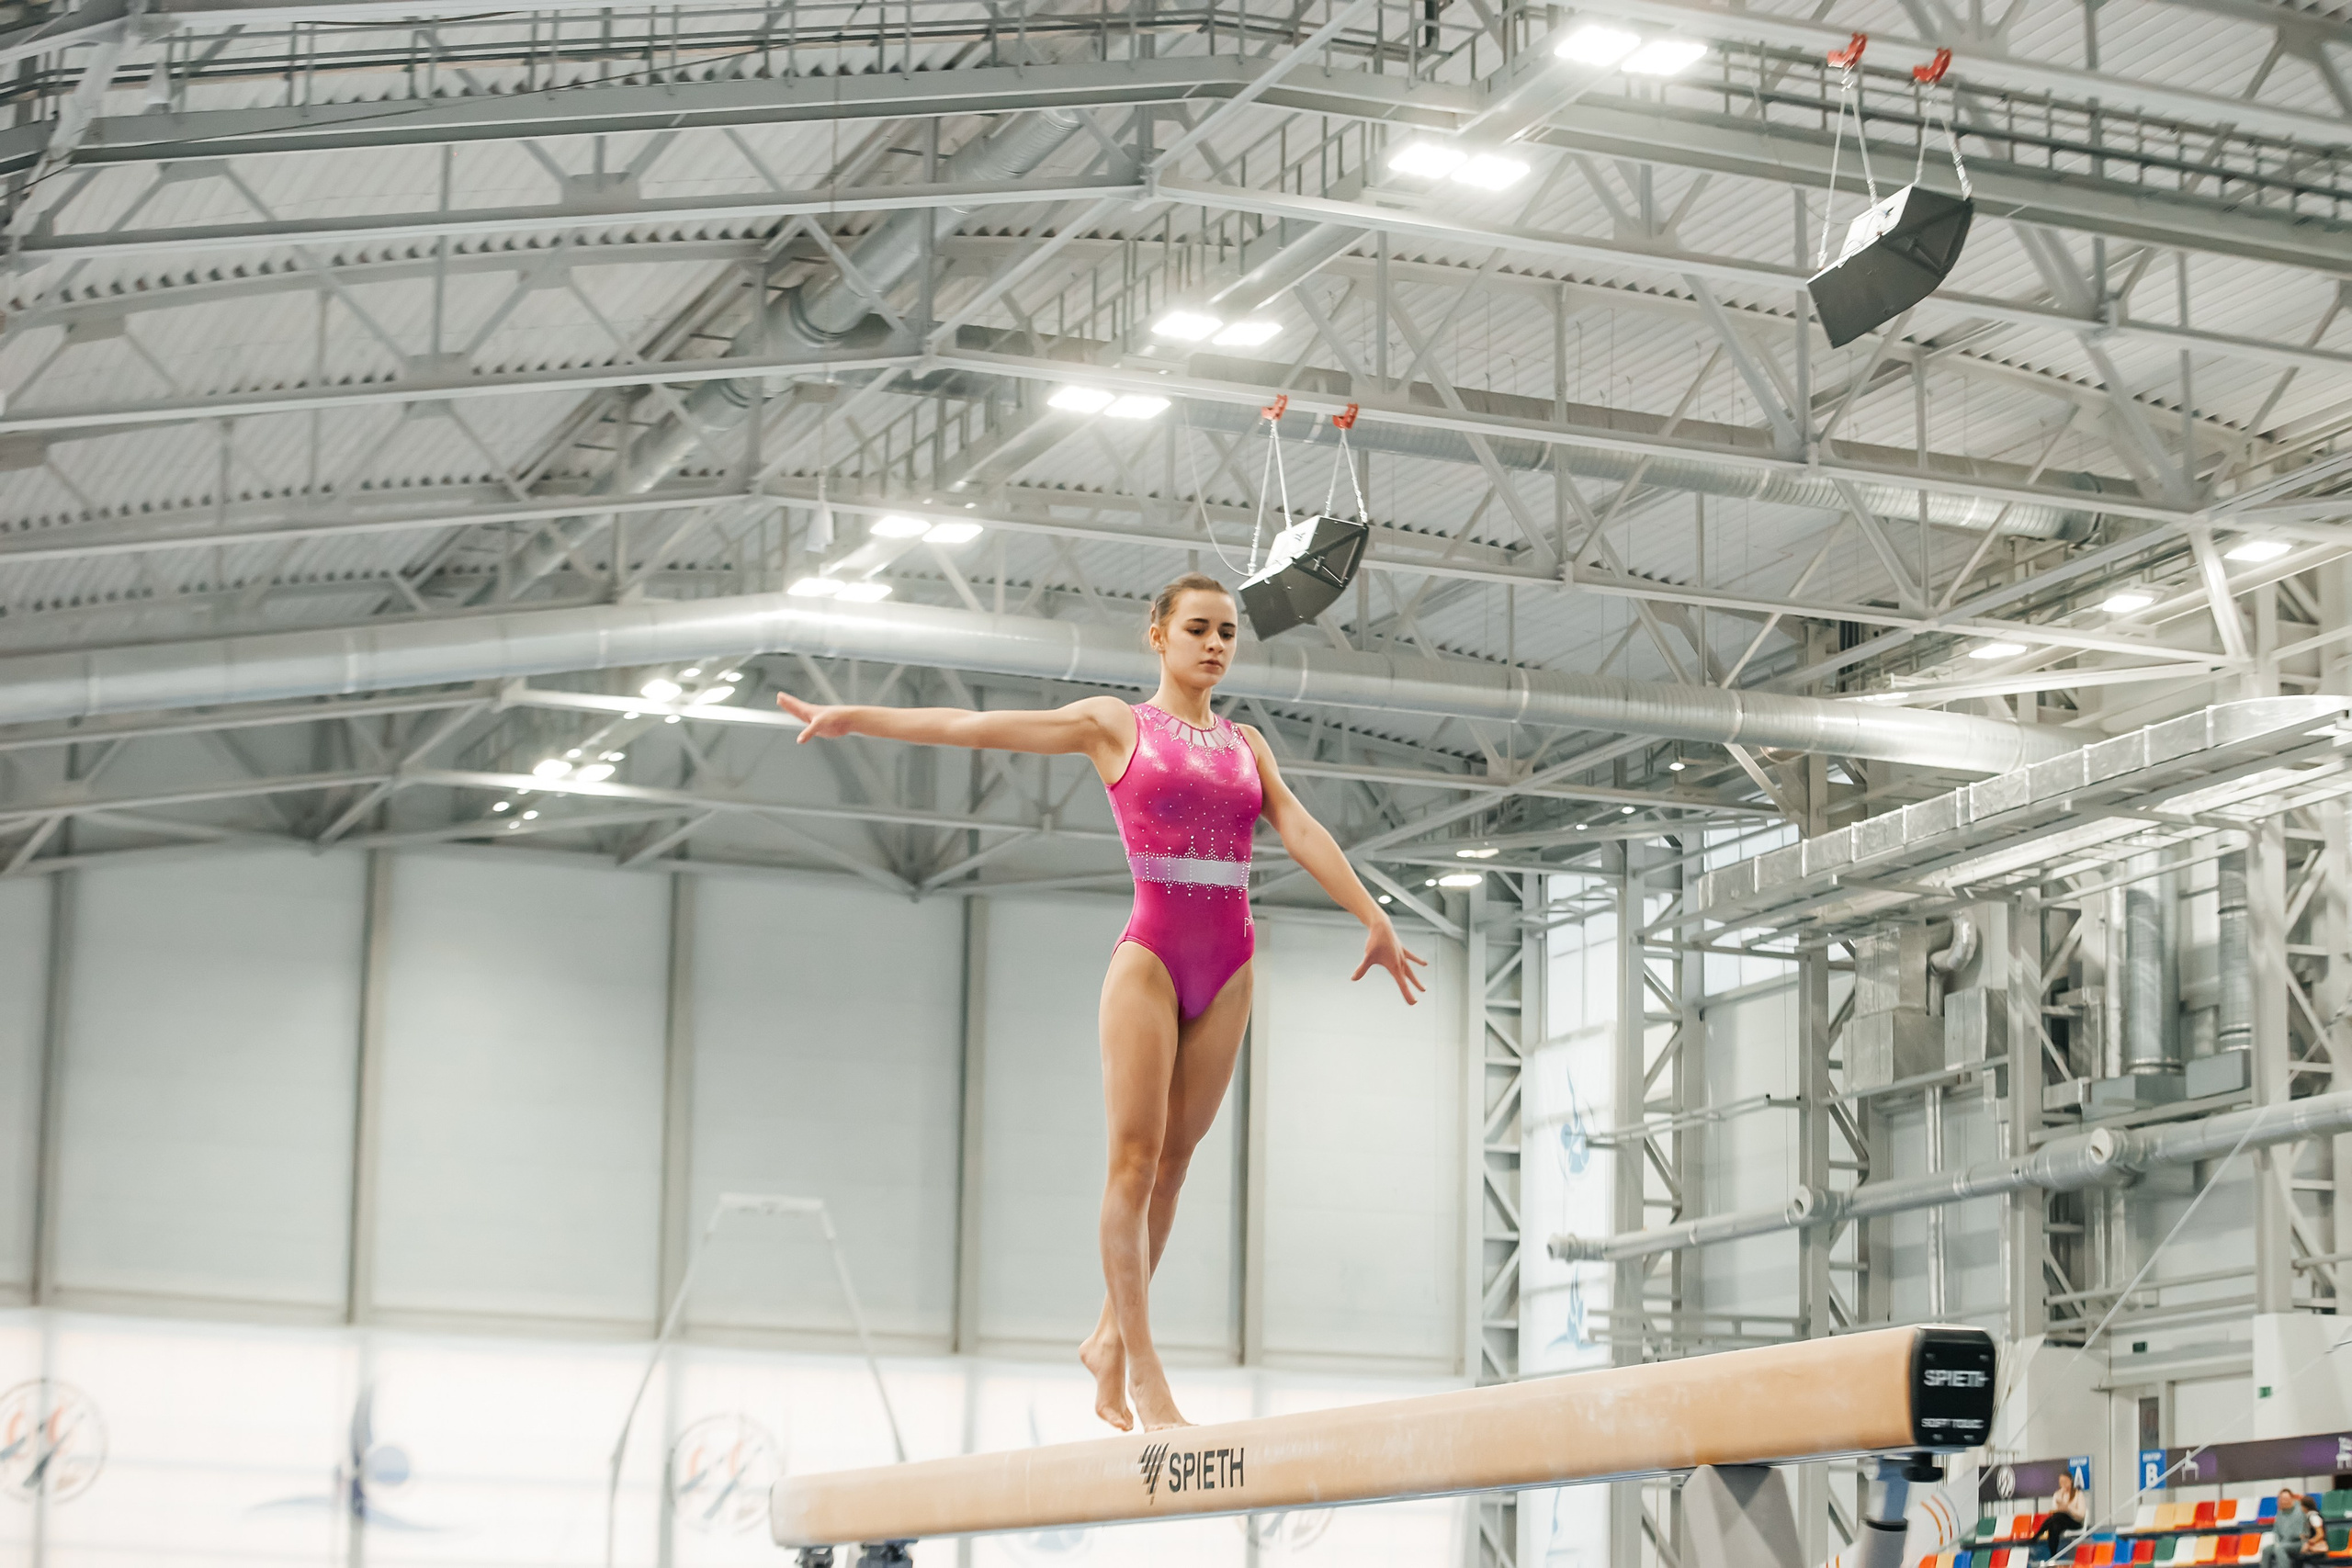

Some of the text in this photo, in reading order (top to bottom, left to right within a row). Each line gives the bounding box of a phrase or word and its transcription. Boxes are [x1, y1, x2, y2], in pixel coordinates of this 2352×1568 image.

[1169, 1447, 1245, 1493] SPIETH
[2073, 1465, 2086, 1489] A
[2145, 1462, 2159, 1488] B
